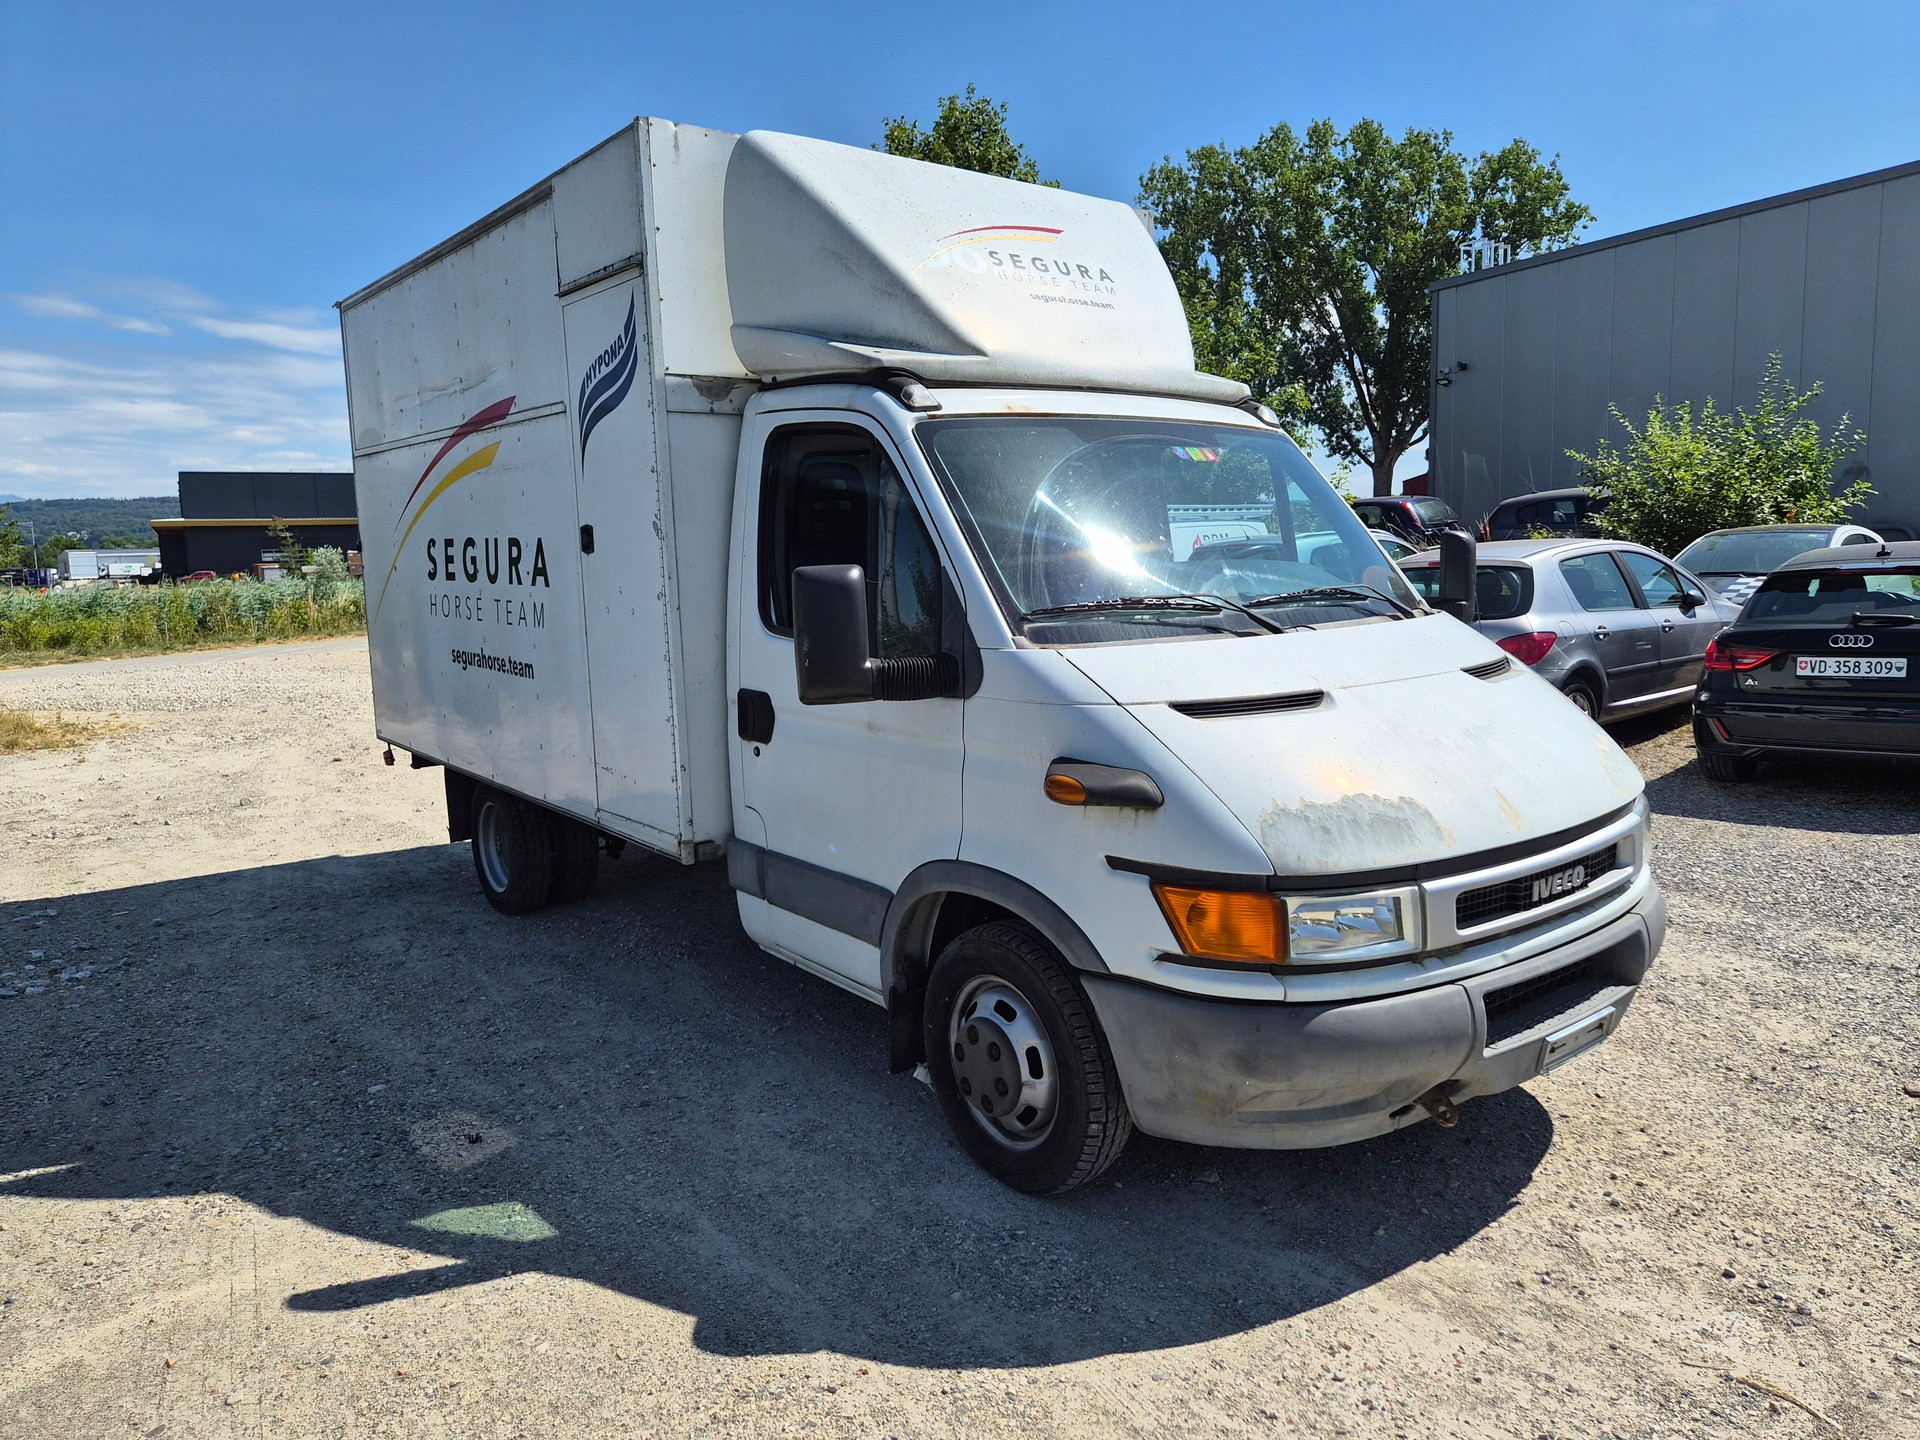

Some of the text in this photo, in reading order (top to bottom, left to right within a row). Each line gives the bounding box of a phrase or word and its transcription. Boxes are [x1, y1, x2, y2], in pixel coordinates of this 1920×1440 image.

[988, 250, 1115, 283] SEGURA
[998, 271, 1117, 296] HORSE TEAM
[1029, 292, 1115, 310] segurahorse.team
[585, 333, 625, 390] HYPONA
[426, 536, 551, 588] SEGURA
[429, 593, 545, 629] HORSE TEAM
[451, 647, 535, 680] segurahorse.team
[1531, 864, 1586, 902] IVECO
